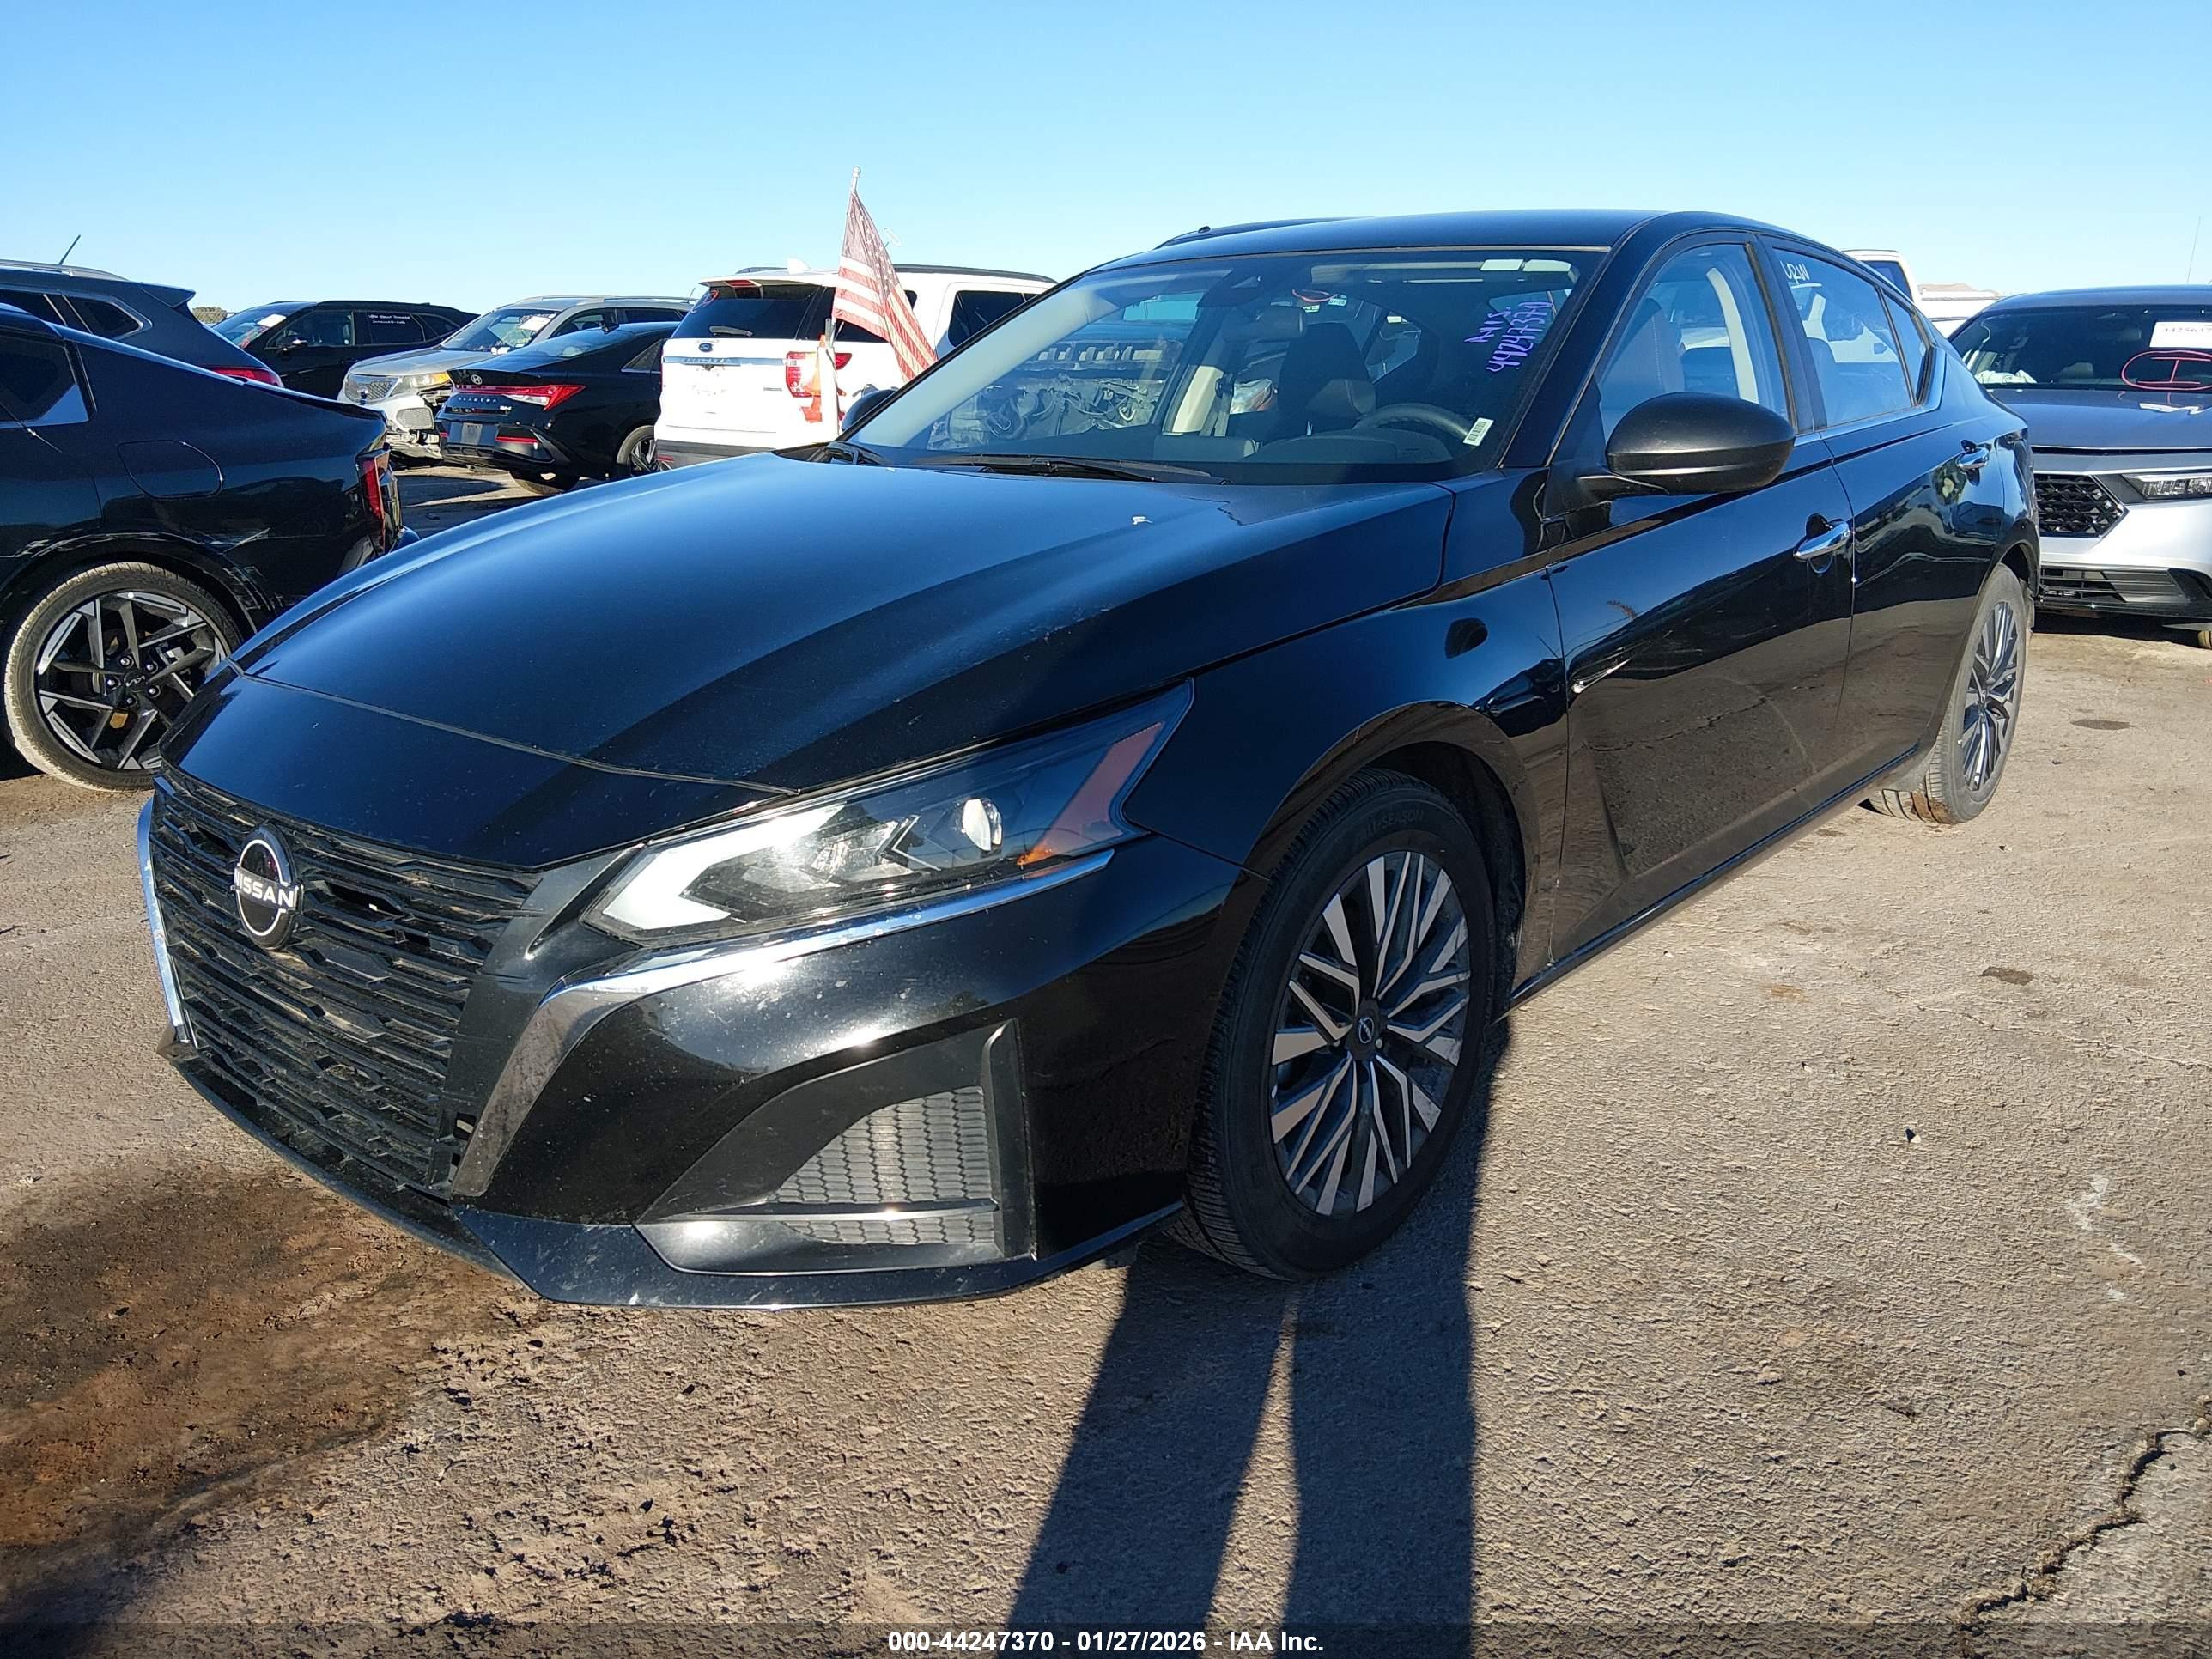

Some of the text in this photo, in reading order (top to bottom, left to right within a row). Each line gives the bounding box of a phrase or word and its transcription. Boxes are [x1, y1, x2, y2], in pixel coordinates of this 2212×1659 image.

[1486, 301, 1553, 373] 44247370
[1362, 809, 1424, 838] LL-SEASON
[234, 866, 296, 908] NISSAN
